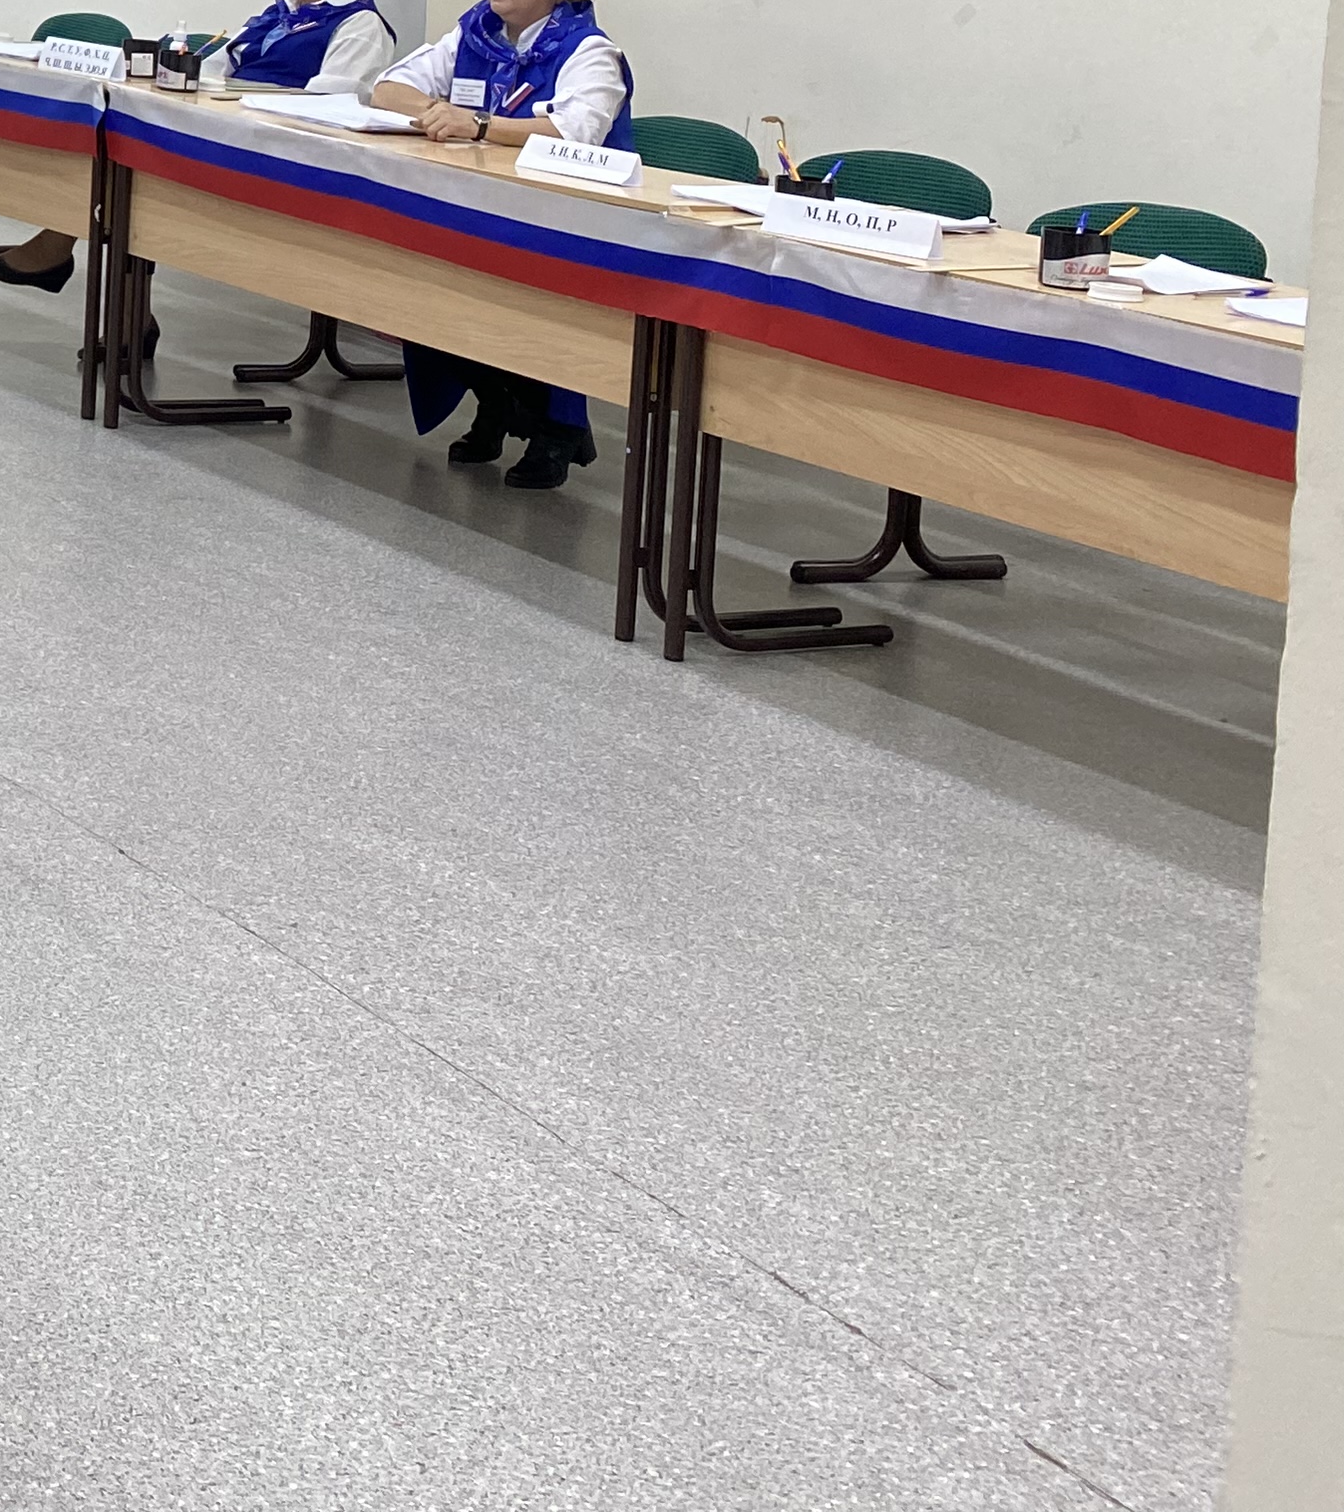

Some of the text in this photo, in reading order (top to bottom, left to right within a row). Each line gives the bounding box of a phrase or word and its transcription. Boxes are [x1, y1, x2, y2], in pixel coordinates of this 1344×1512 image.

[804, 205, 897, 232] М, Н, О, П, Р
